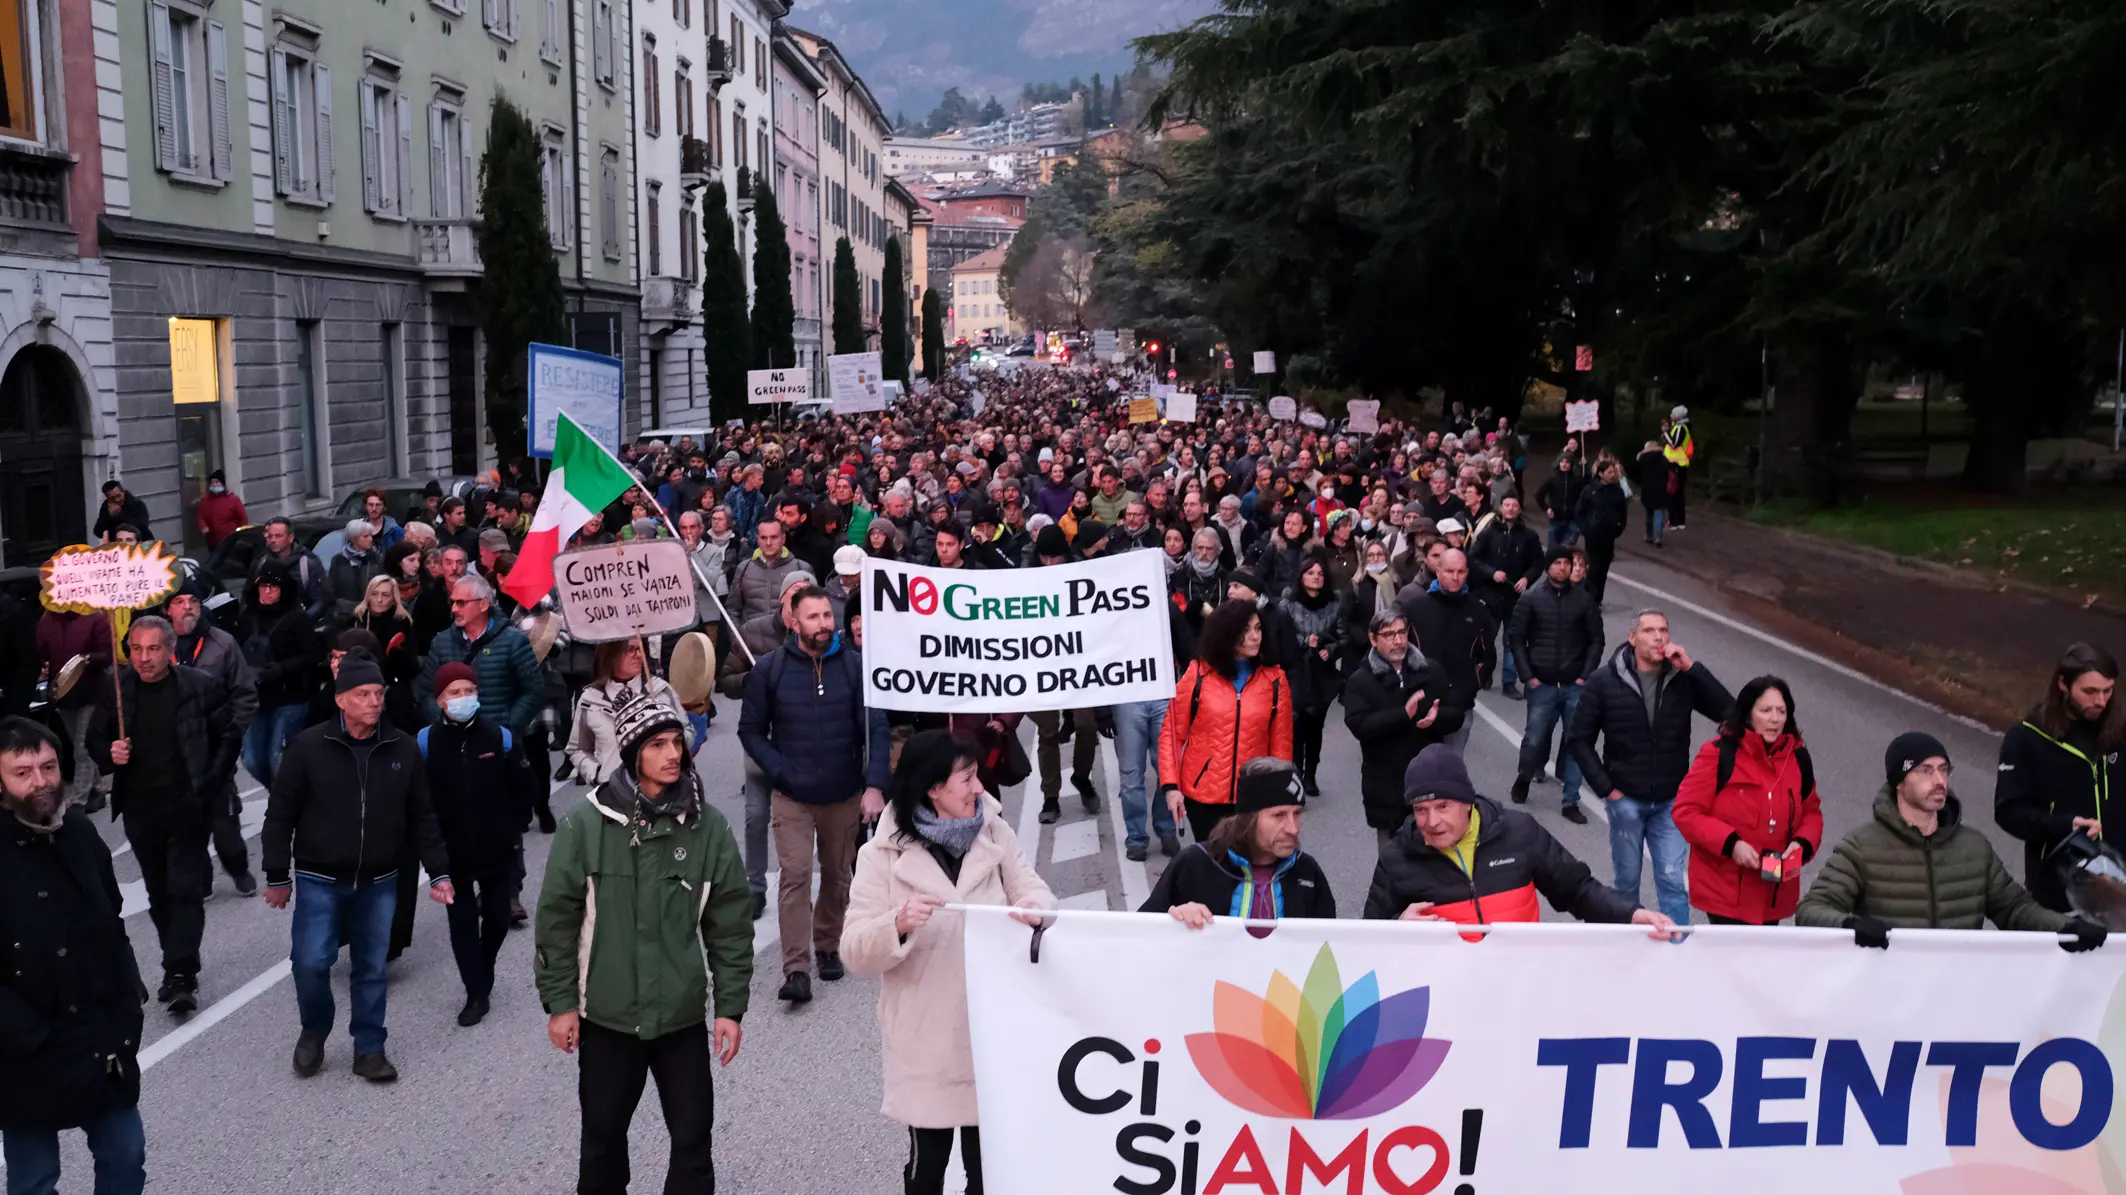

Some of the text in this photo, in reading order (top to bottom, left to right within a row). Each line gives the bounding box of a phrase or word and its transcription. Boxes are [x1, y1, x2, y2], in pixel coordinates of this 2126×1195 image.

[754, 385, 806, 396] GREEN PASS
[770, 372, 785, 382] NO
[72, 551, 119, 566] GOVERNO
[129, 564, 145, 577] HA
[566, 554, 650, 586] COMPREN
[56, 578, 164, 601] AUMENTATO PURE IL
[620, 582, 635, 598] SE
[641, 574, 682, 595] VANZA
[943, 584, 1060, 621] GREEN
[1065, 578, 1151, 617] PASS
[585, 595, 691, 624] SOLDI DAI TAMPONI
[920, 631, 1083, 661] DIMISSIONI
[872, 658, 1157, 697] GOVERNO DRAGHI
[1057, 1036, 1162, 1116] Ci
[1537, 1037, 2114, 1151] TRENTO
